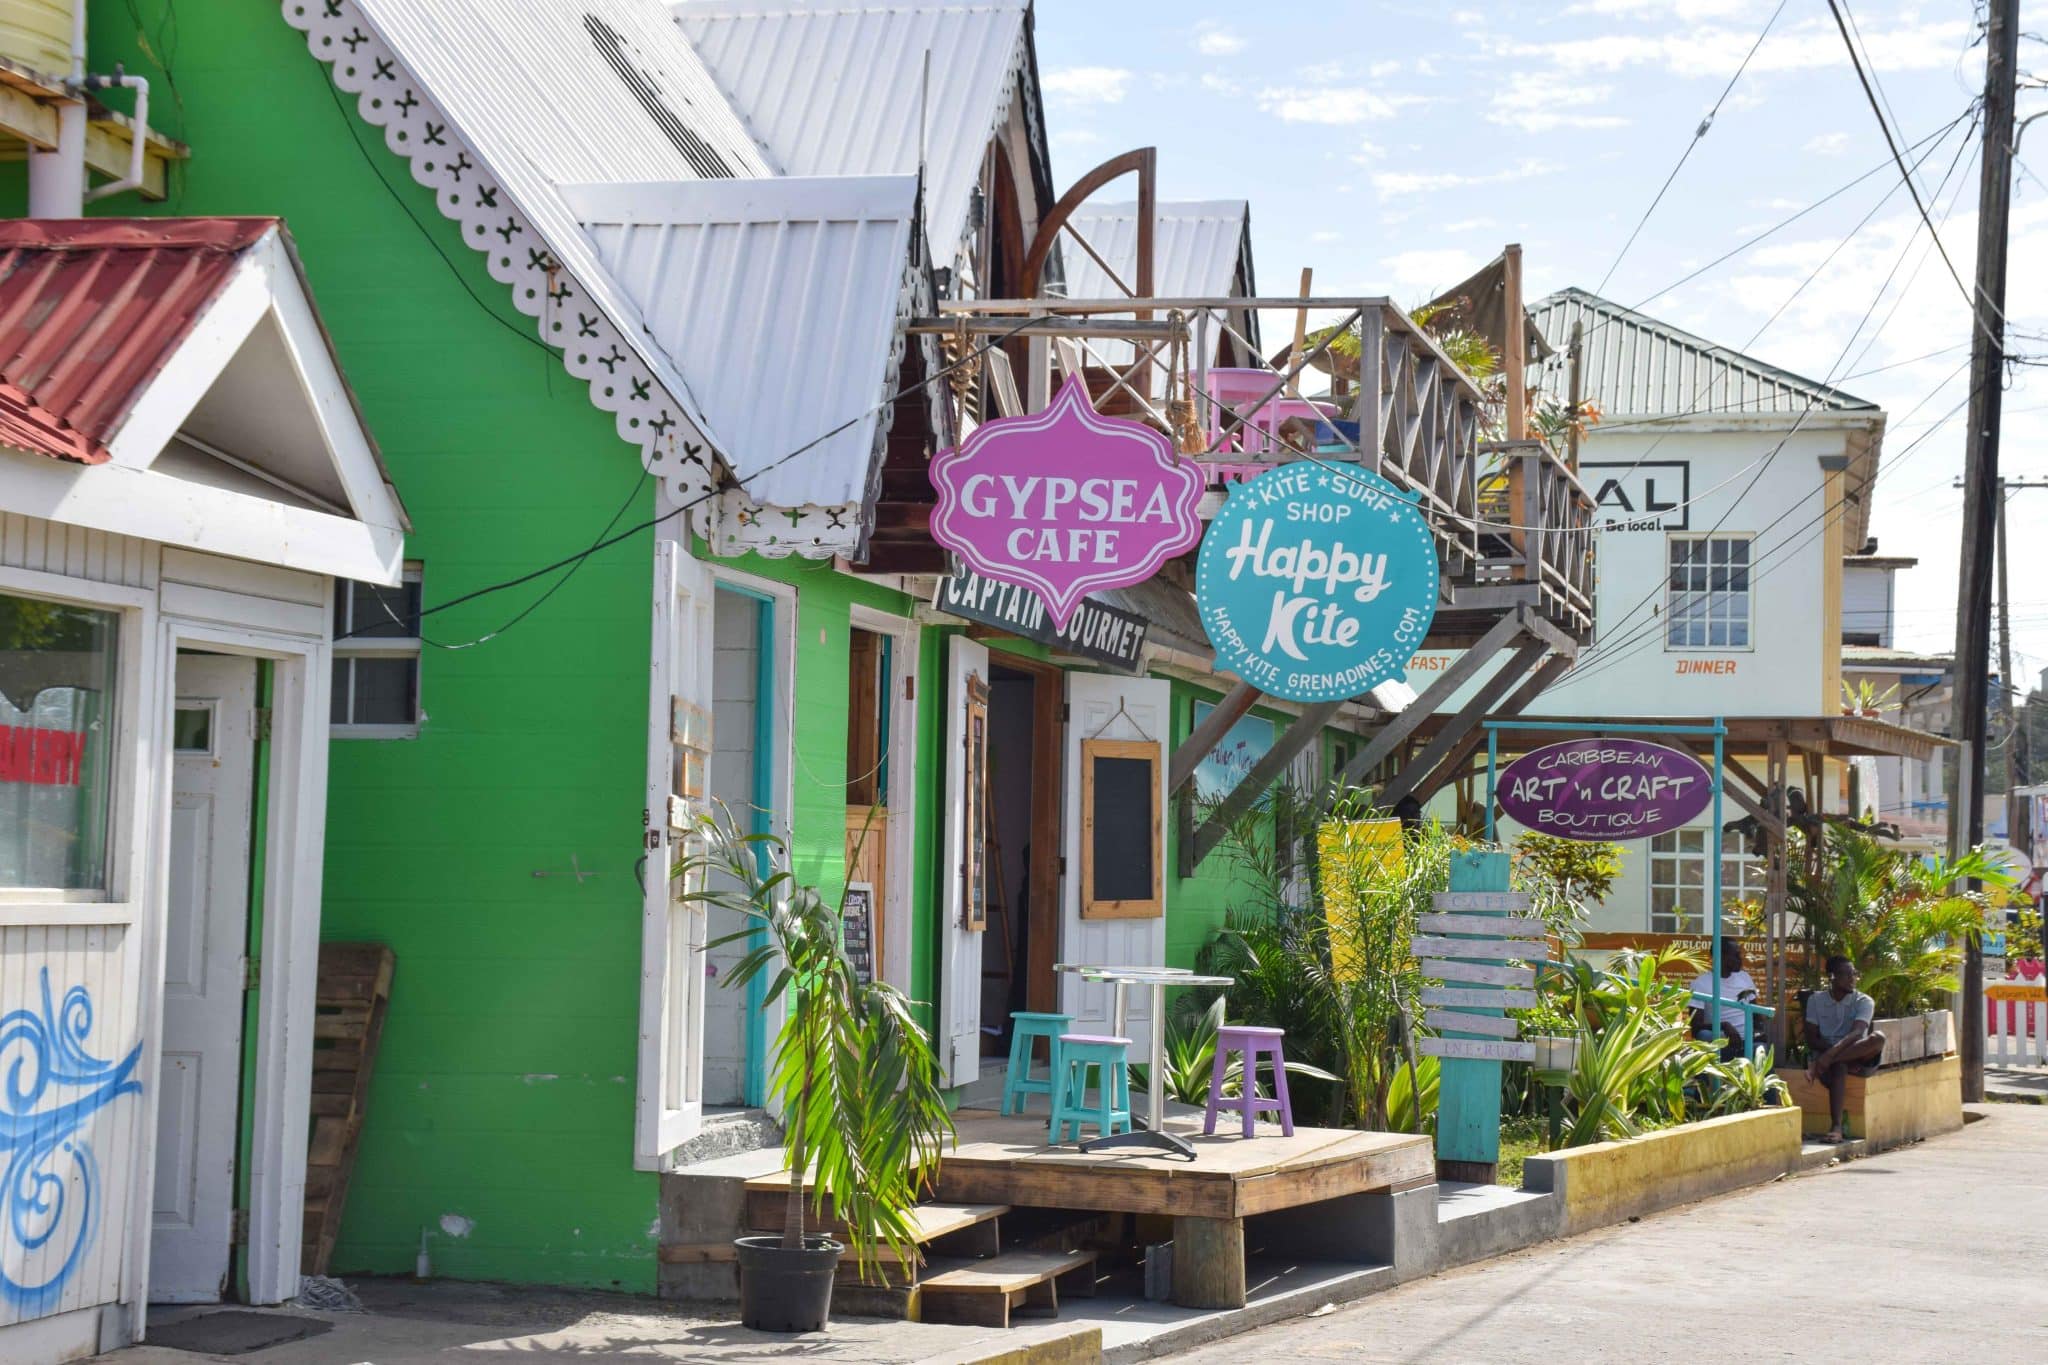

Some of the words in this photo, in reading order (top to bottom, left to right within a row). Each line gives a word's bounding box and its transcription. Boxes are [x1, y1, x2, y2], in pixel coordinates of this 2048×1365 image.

[960, 473, 1174, 524] GYPSEA
[1259, 474, 1311, 506] KITE
[1331, 476, 1392, 511] SURF
[1287, 503, 1351, 524] SHOP
[1007, 527, 1120, 563] CAFE
[1226, 518, 1392, 603] Happy
[948, 574, 1045, 630] CAPTAIN
[1056, 604, 1145, 661] OURMET
[1261, 591, 1361, 661] Kite
[1213, 607, 1249, 656] HAPPY
[1245, 655, 1280, 682] KITE
[1675, 660, 1737, 674] DINNER
[1537, 749, 1663, 770] CARIBBEAN
[1511, 777, 1567, 802] ART
[1600, 775, 1694, 801] CRAFT
[1538, 808, 1663, 827] BOUTIQUE
[1672, 940, 1713, 951] WELCO
